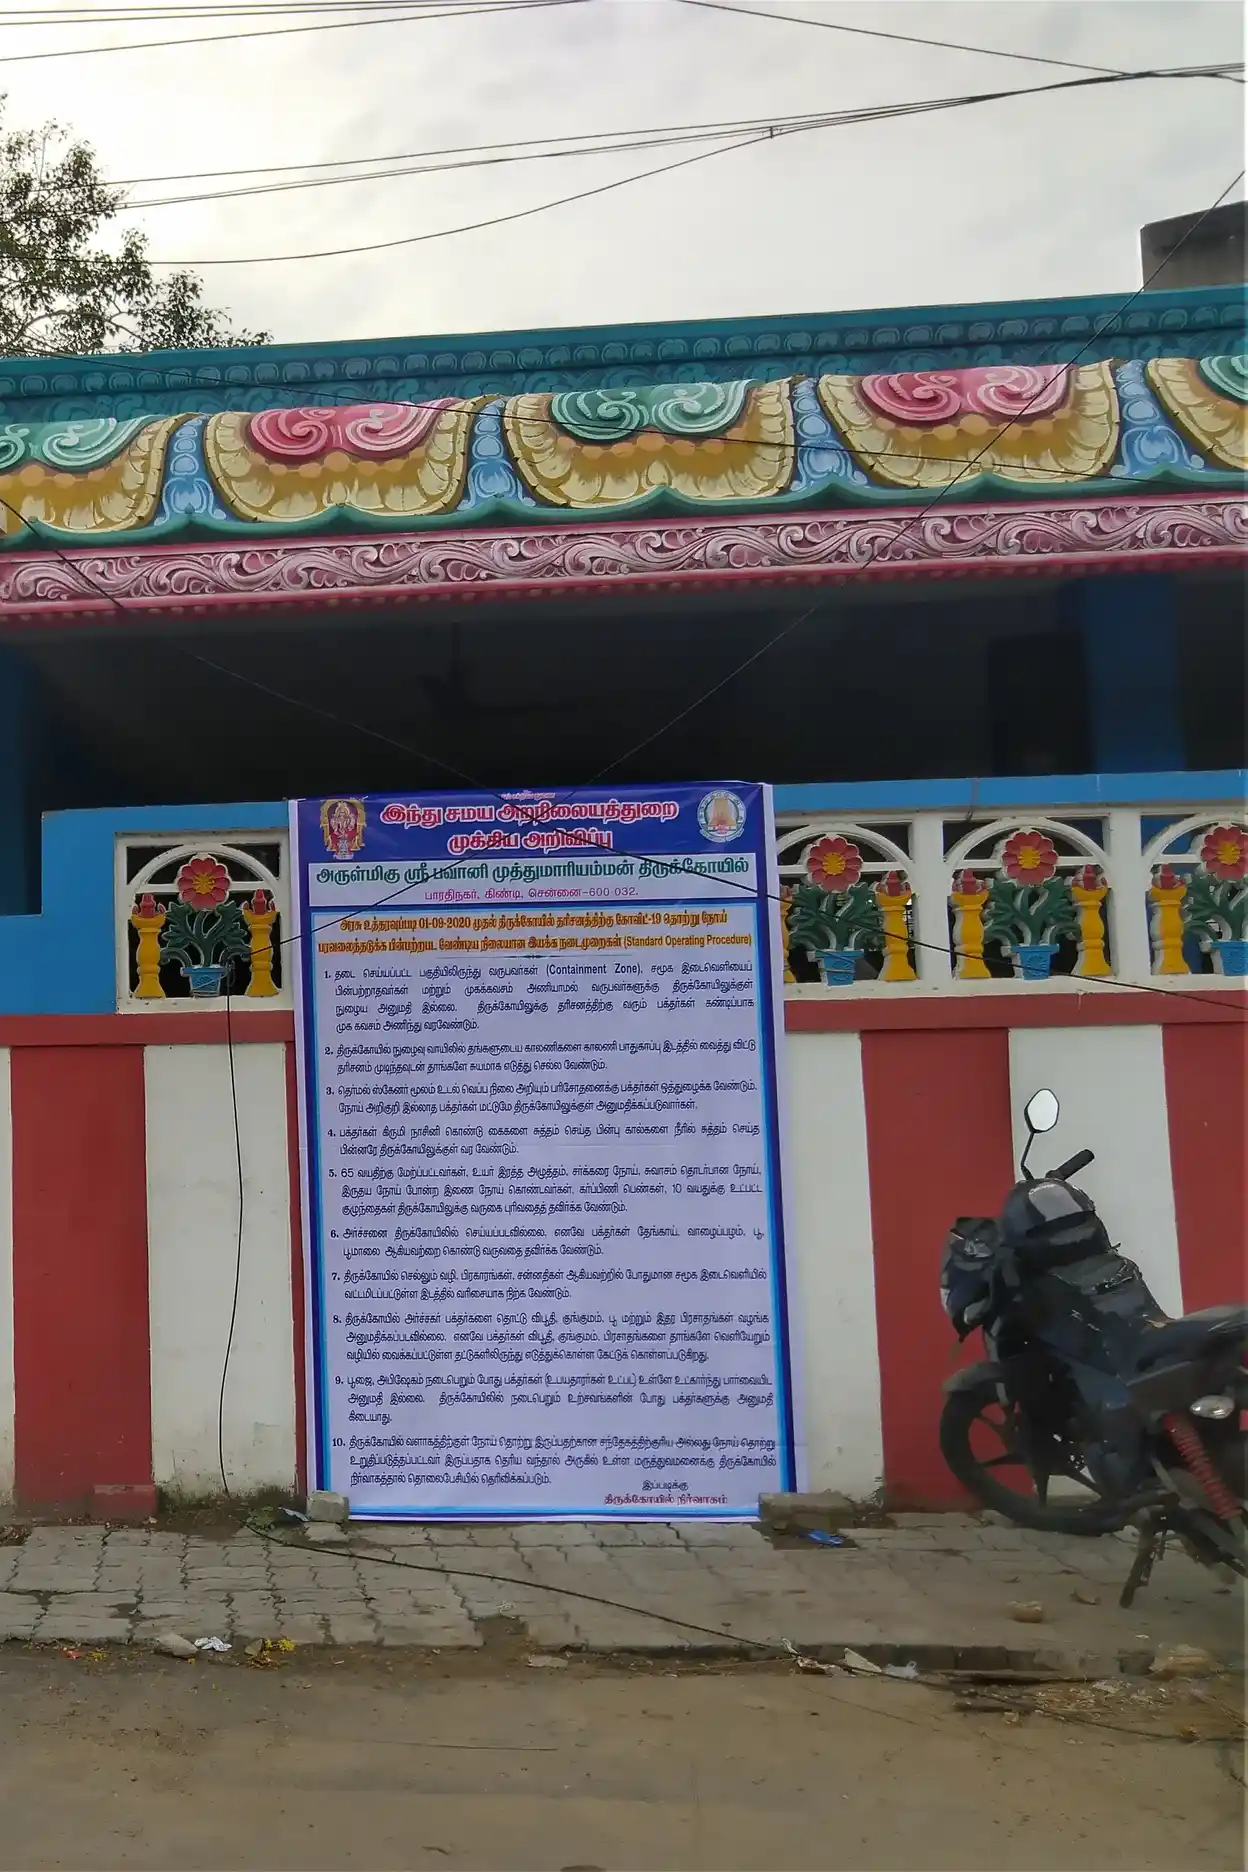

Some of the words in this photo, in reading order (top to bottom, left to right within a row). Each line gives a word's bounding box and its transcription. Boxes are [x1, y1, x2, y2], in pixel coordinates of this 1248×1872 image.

[380, 802, 443, 827] இந்து
[445, 803, 494, 824] சமய
[497, 798, 678, 827] அறநிலையத்துறை
[448, 829, 518, 855] முக்கிய
[521, 827, 612, 855] அறிவிப்பு
[316, 865, 400, 885] அருள்மிகு
[433, 863, 489, 881] பவானி
[493, 859, 634, 884] முத்துமாரியம்மன்
[639, 857, 749, 879] திருக்கோயில்
[340, 918, 362, 931] அரசு
[419, 917, 470, 929] 01-09-2020
[473, 914, 496, 931] முதல்
[498, 913, 554, 931] திருக்கோயில்
[664, 910, 700, 928] தொற்று
[702, 909, 728, 926] நோய்
[439, 936, 478, 952] வேண்டிய
[481, 936, 526, 952] நிலையான
[559, 934, 622, 951] நடைமுறைகள்
[624, 934, 663, 949] (Standard
[666, 934, 704, 948] Operating
[707, 933, 751, 946] Procedure)
[334, 970, 355, 983] தடை
[363, 966, 411, 981] செய்யப்பட்ட
[420, 965, 481, 982] பகுதியிலிருந்து
[489, 964, 538, 979] வருபவர்கள்
[546, 963, 606, 978] (Containment
[651, 964, 673, 976] சமூக
[336, 983, 408, 1000] பின்பற்றாதவர்கள்
[422, 982, 451, 999] மற்றும்
[465, 981, 513, 997] முகக்கவசம்
[527, 979, 578, 994] அணியாமல்
[592, 979, 659, 997] வருபவர்களுக்கு
[673, 977, 753, 994] திருக்கோயிலுக்குள்
[336, 1004, 368, 1019] நுழைய
[378, 1001, 411, 1018] அனுமதி
[477, 999, 547, 1015] திருக்கோயிலுக்கு
[558, 998, 613, 1013] தரிசனத்திற்கு
[623, 996, 647, 1012] வரும்
[657, 998, 695, 1012] பக்தர்கள்
[706, 994, 754, 1010] கண்டிப்பாக
[336, 1018, 352, 1034] முக
[354, 1018, 380, 1031] கவசம்
[383, 1017, 421, 1034] அணிந்து
[337, 1043, 391, 1058] திருக்கோயில்
[394, 1044, 425, 1059] நுழைவு
[427, 1041, 465, 1056] வாயிலில்
[467, 1042, 522, 1057] தங்களுடைய
[525, 1041, 582, 1053] காலணிகளை
[584, 1040, 617, 1052] காலணி
[619, 1043, 660, 1055] பாதுகாப்பு
[663, 1038, 697, 1055] இடத்தில்
[700, 1041, 731, 1054] வைத்து
[734, 1038, 756, 1052] விட்டு
[337, 1060, 372, 1076] தரிசனம்
[427, 1060, 467, 1075] தாங்களே
[504, 1059, 532, 1074] எடுத்து
[534, 1058, 561, 1070] செல்ல
[341, 1140, 377, 1157] பின்னரே
[380, 1142, 458, 1159] திருக்கோயிலுக்குள்
[461, 1143, 473, 1156] வர
[342, 1200, 395, 1217] குழந்தைகள்
[398, 1200, 468, 1216] திருக்கோயிலுக்கு
[471, 1204, 502, 1216] வருகை
[549, 1199, 581, 1216] தவிர்க்க
[343, 1247, 380, 1260] பூமாலை
[385, 1243, 440, 1259] ஆகியவற்றை
[443, 1243, 480, 1258] கொண்டு
[482, 1243, 522, 1259] வருவதை
[524, 1243, 558, 1260] தவிர்க்க
[420, 1286, 454, 1302] இடத்தில்
[457, 1286, 504, 1298] வரிசையாக
[507, 1284, 526, 1302] நிற்க
[347, 1348, 379, 1364] வழியில்
[597, 1347, 628, 1362] கேட்டுக்
[377, 1373, 423, 1389] அபிஷேகம்
[426, 1373, 474, 1390] நடைபெறும்
[477, 1373, 502, 1390] போது
[504, 1372, 542, 1388] பக்தர்கள்
[639, 1373, 672, 1385] உள்ளே
[348, 1390, 383, 1408] அனுமதி
[439, 1390, 503, 1407] திருக்கோயிலில்
[511, 1391, 560, 1407] நடைபெறும்
[640, 1392, 665, 1407] போது
[673, 1391, 729, 1407] பக்தர்களுக்கு
[737, 1392, 773, 1408] அனுமதி
[351, 1470, 405, 1487] நிர்வாகத்தால்
[408, 1471, 478, 1487] தொலைபேசியில்
[604, 1493, 674, 1505] திருக்கோயில்
